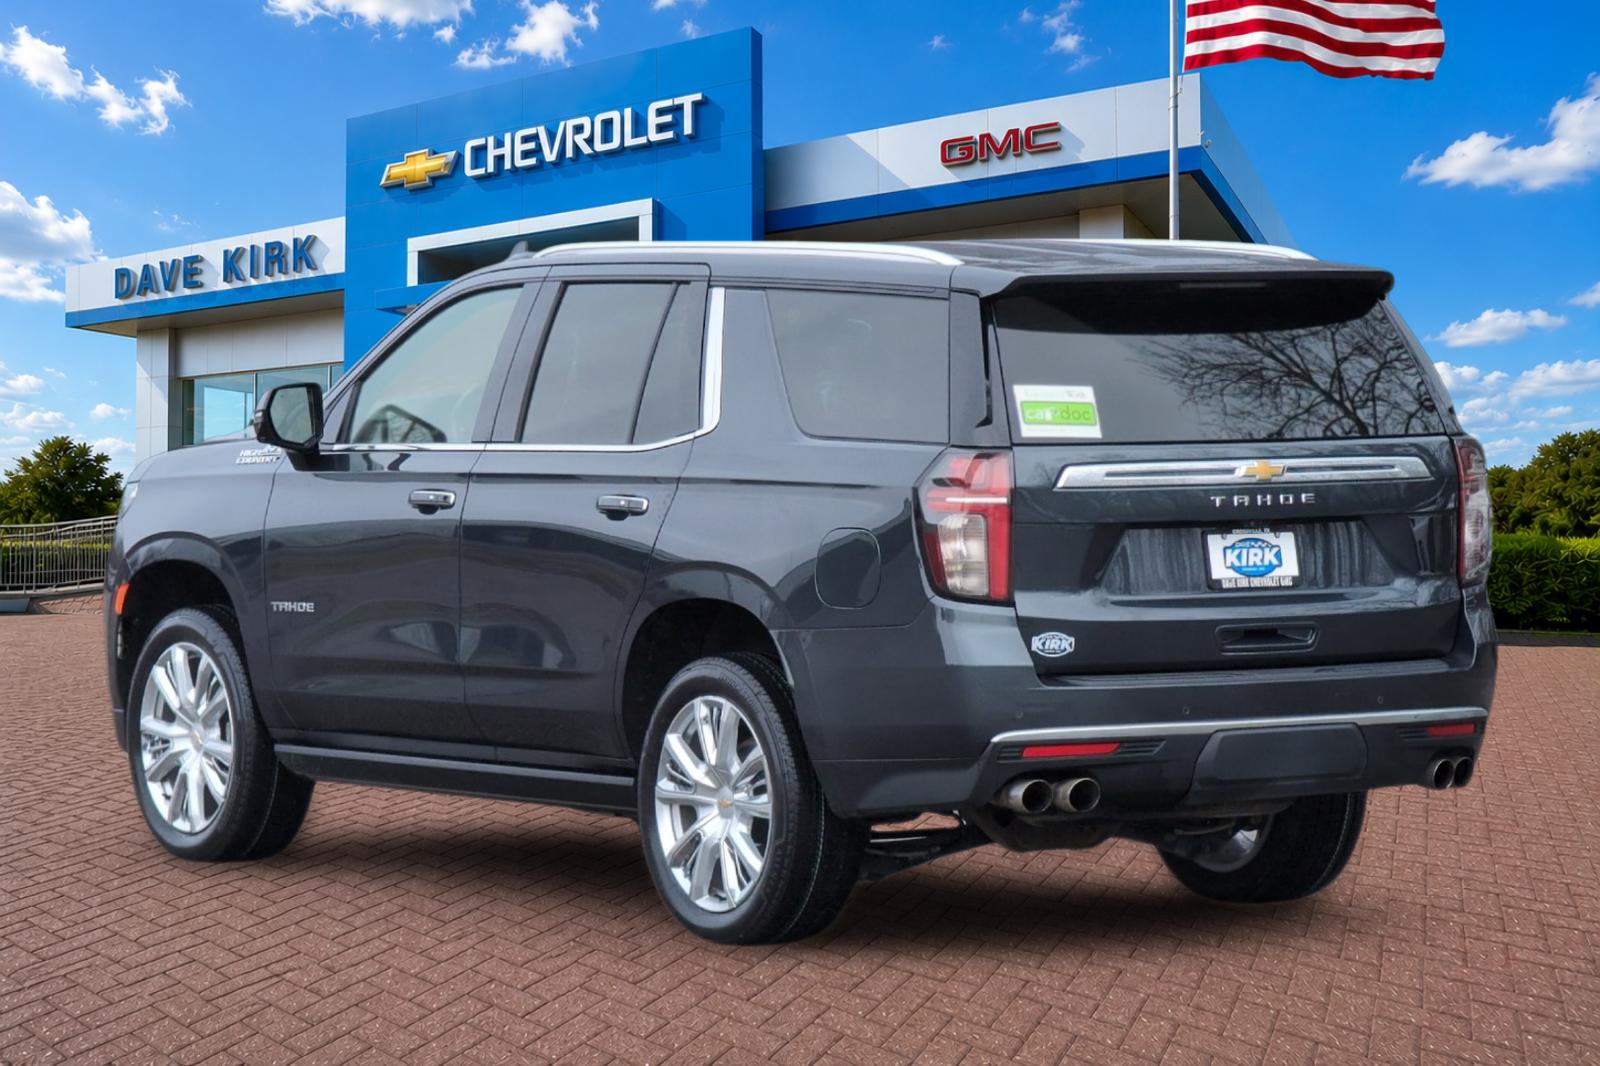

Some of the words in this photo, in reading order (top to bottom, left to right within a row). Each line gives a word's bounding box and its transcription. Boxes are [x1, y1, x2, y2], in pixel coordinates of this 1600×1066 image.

[464, 92, 703, 177] CHEVROLET
[940, 121, 1060, 166] GMC
[115, 254, 203, 299] DAVE
[222, 235, 318, 283] KIRK
[1210, 493, 1315, 507] TAHOE
[1225, 547, 1280, 567] KIRK
[270, 601, 314, 612] TAHOE
[1034, 638, 1072, 650] KIRK
